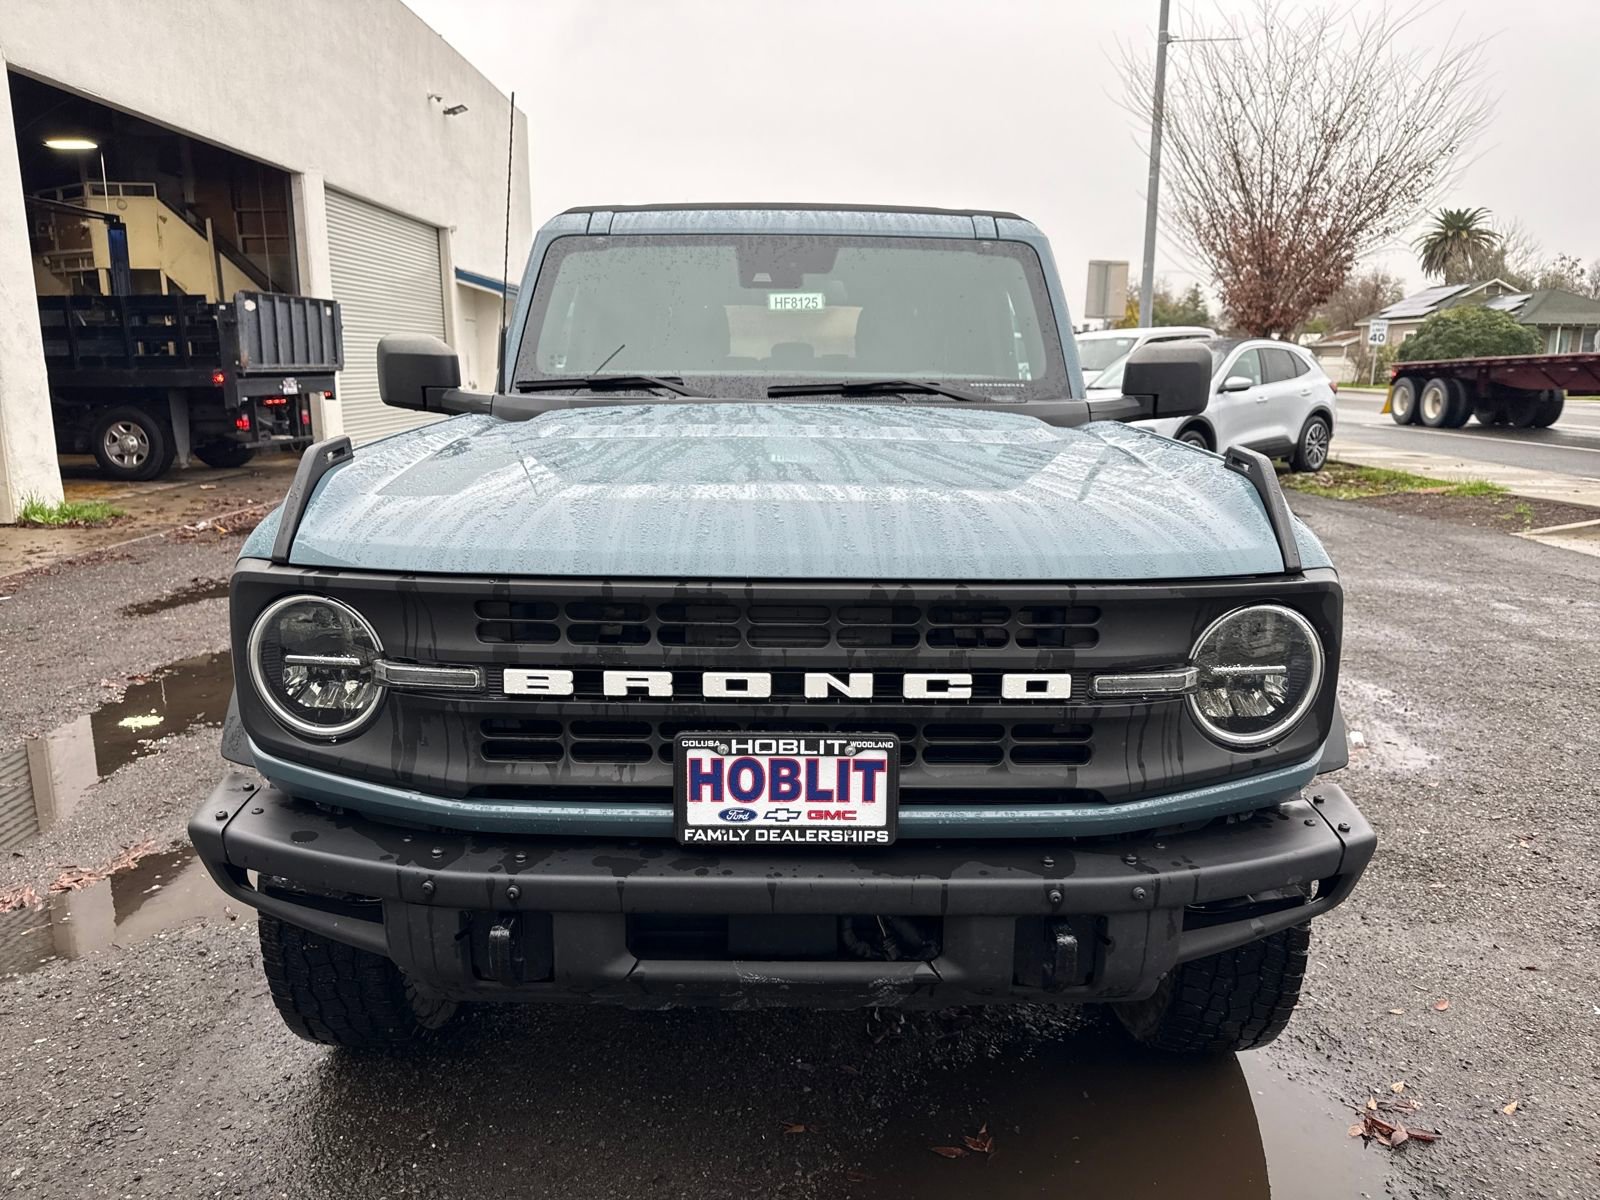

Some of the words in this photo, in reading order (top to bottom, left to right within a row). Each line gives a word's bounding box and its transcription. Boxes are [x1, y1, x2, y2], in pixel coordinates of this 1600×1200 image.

[774, 296, 818, 309] HF8125
[1370, 333, 1385, 342] 40
[503, 668, 1071, 699] BRONCO
[731, 739, 847, 755] HOBLIT
[688, 757, 886, 804] HOBLIT
[726, 809, 750, 821] Ford
[807, 809, 857, 821] GMC
[684, 829, 750, 841] FAMILY
[755, 829, 889, 843] DEALERSHIPS
